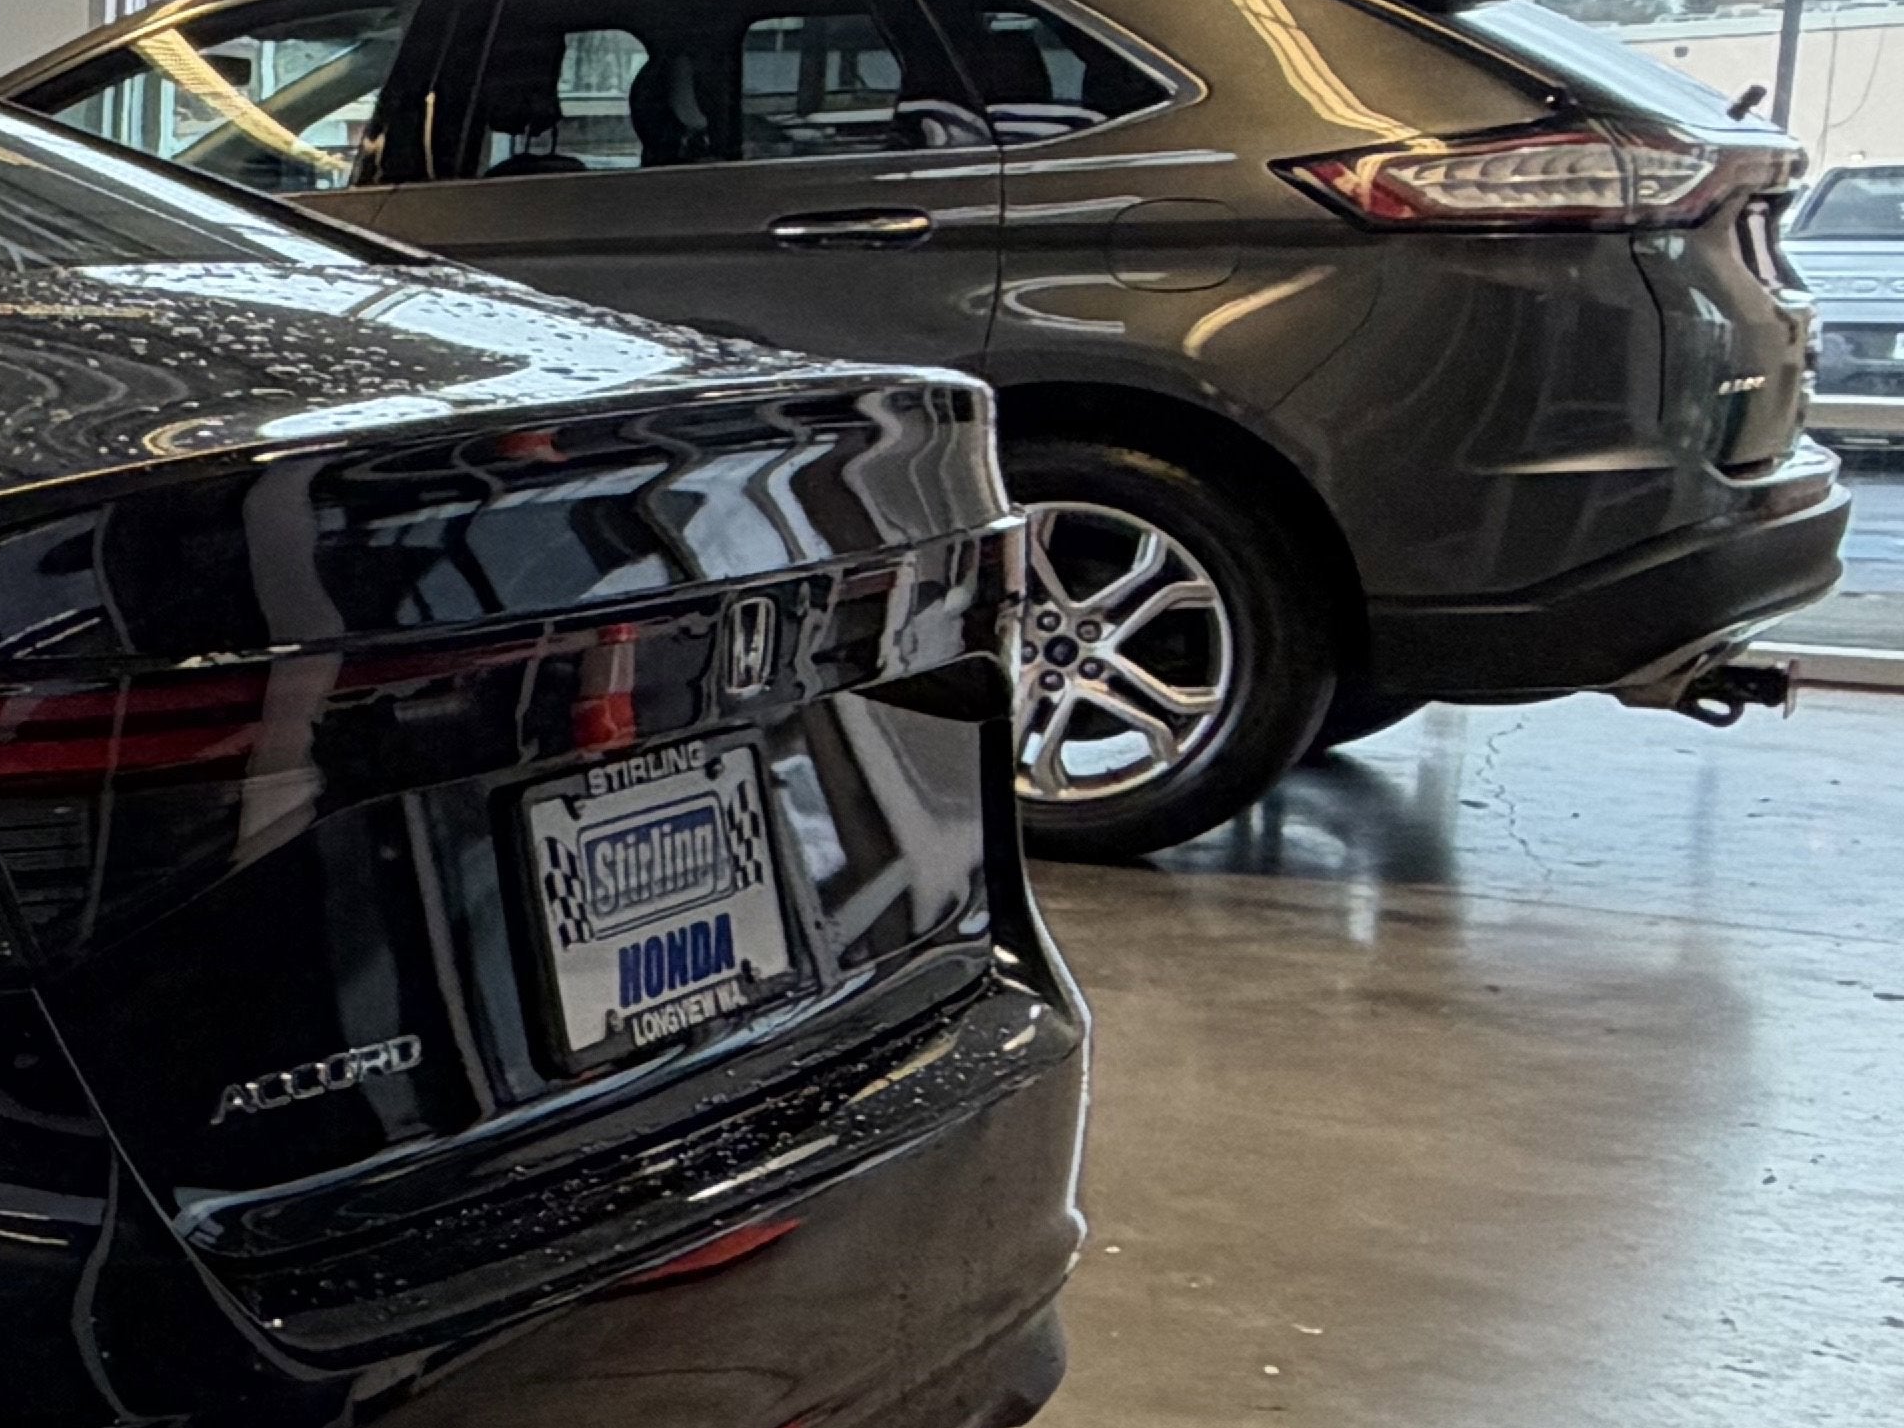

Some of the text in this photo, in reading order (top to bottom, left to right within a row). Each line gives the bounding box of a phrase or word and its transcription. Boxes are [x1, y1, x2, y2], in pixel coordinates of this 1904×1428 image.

[588, 740, 706, 795] STIRLING
[619, 913, 735, 1008] HONDA
[633, 989, 717, 1047] LONGVIEW
[210, 1034, 422, 1125] ACCORD
